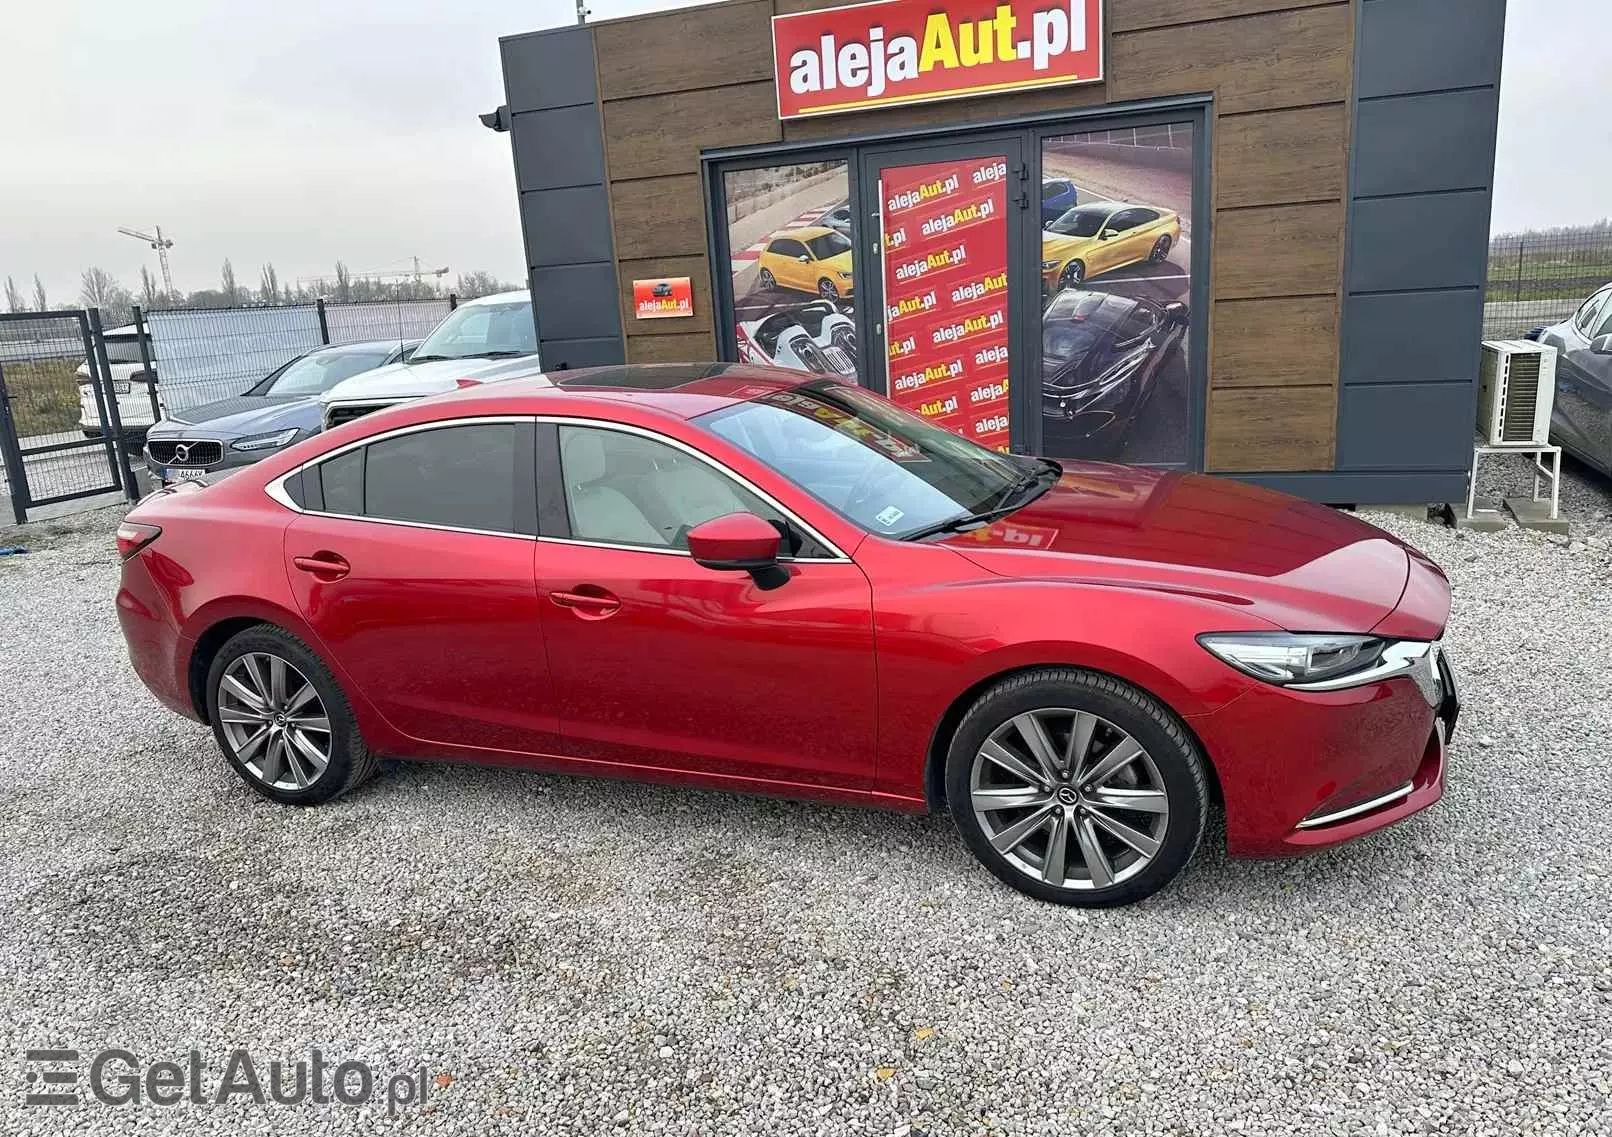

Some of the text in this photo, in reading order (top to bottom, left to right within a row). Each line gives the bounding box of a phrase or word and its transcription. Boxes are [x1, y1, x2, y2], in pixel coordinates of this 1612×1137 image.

[789, 0, 1087, 97] alejaAut.pl
[972, 162, 1007, 183] aleja
[887, 174, 959, 212] alejaAut.pl
[921, 199, 994, 235] alejaAut.pl
[895, 245, 966, 280] alejaAut.pl
[951, 272, 1007, 302] alejaAut
[639, 298, 689, 312] alejaAut.pl
[887, 290, 937, 321] jaAut.pl
[932, 310, 1003, 343] alejaAut.pl
[975, 346, 1008, 364] aleja
[894, 359, 963, 390] alejaAut.pl
[975, 415, 1008, 433] aleja
